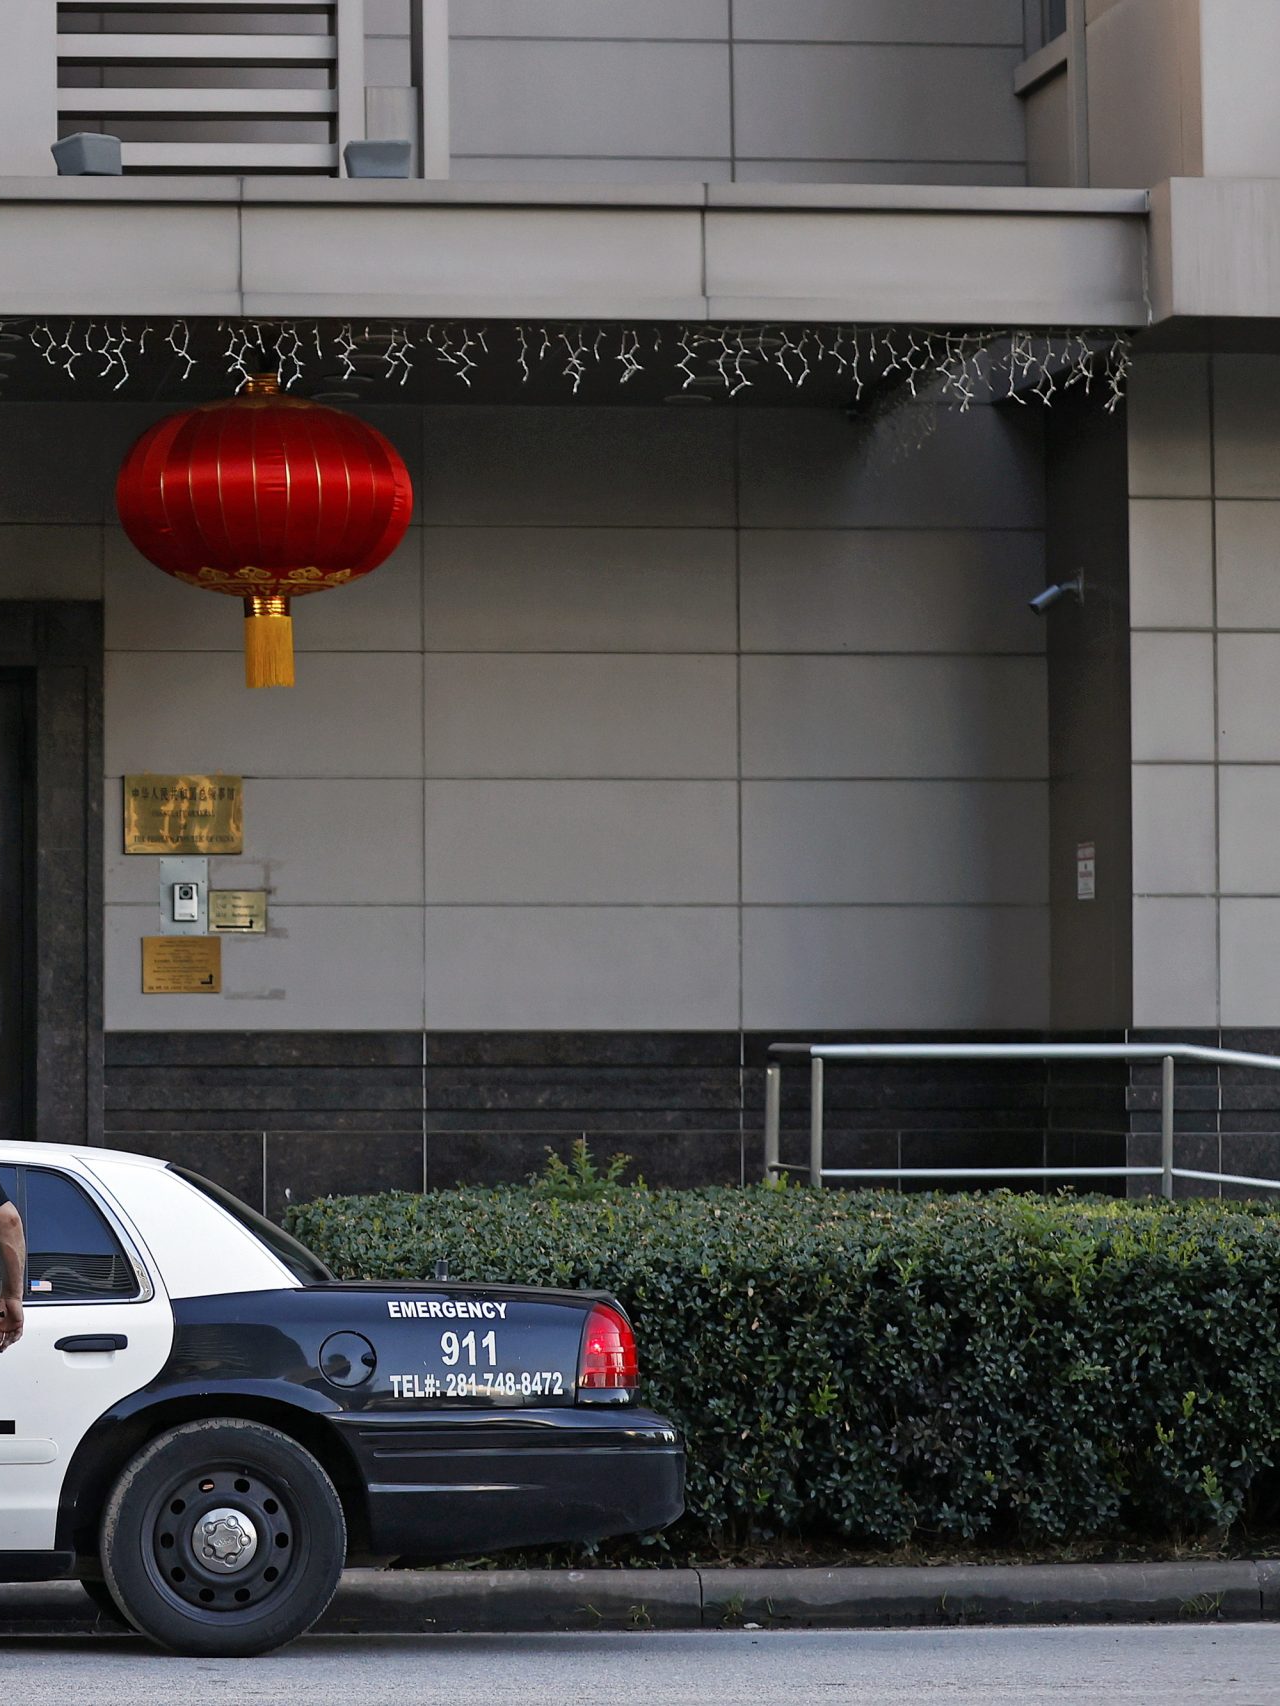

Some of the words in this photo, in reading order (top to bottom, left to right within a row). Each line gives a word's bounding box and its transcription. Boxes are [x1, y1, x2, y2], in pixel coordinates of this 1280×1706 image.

[387, 1301, 507, 1319] EMERGENCY
[440, 1330, 497, 1366] 911
[389, 1374, 441, 1398] TEL#:
[446, 1371, 564, 1397] 281-748-8472
